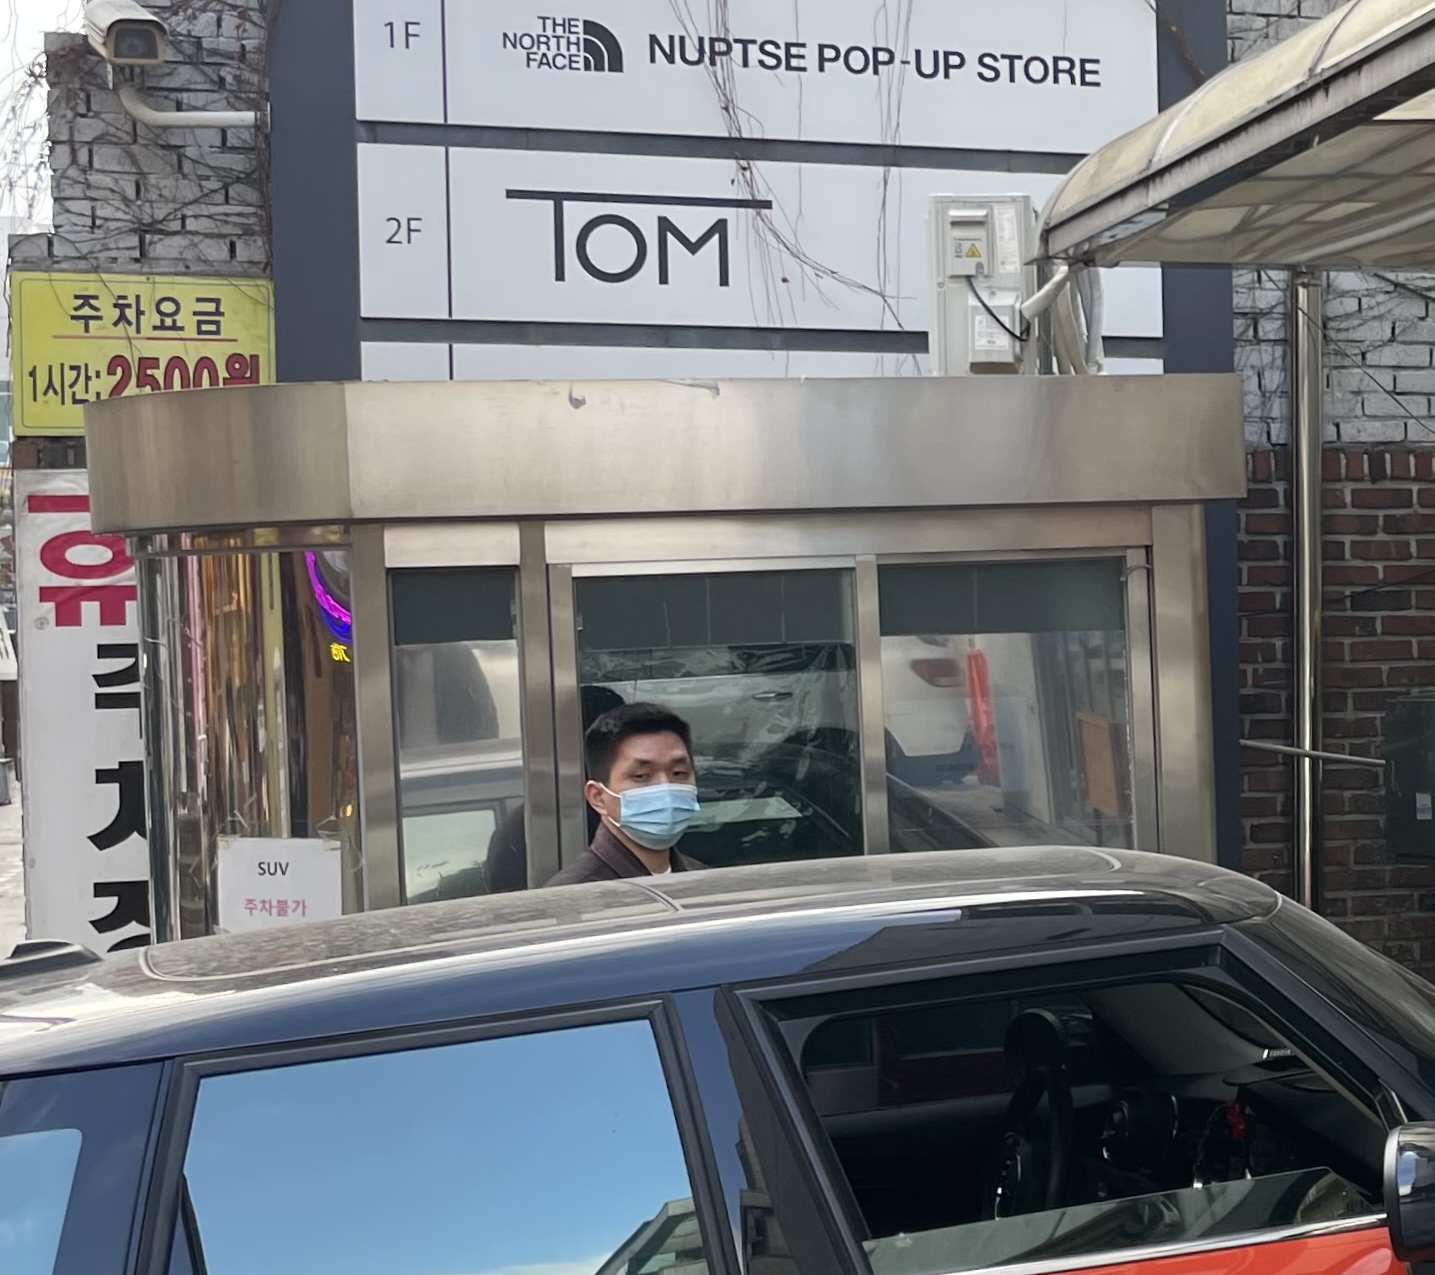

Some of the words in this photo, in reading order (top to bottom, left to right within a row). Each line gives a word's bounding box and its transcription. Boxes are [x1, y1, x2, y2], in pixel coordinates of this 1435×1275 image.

[383, 21, 421, 50] 1F
[537, 16, 580, 34] THE
[502, 32, 580, 53] NORTH
[526, 52, 581, 71] FACE
[649, 34, 808, 73] NUPTSE
[817, 43, 966, 81] POP-UP
[977, 50, 1101, 87] STORE
[384, 216, 423, 246] 2F
[506, 189, 772, 287] TOM
[70, 294, 225, 336] 주차요금
[257, 861, 289, 876] SUV
[244, 898, 308, 917] 주차불가
